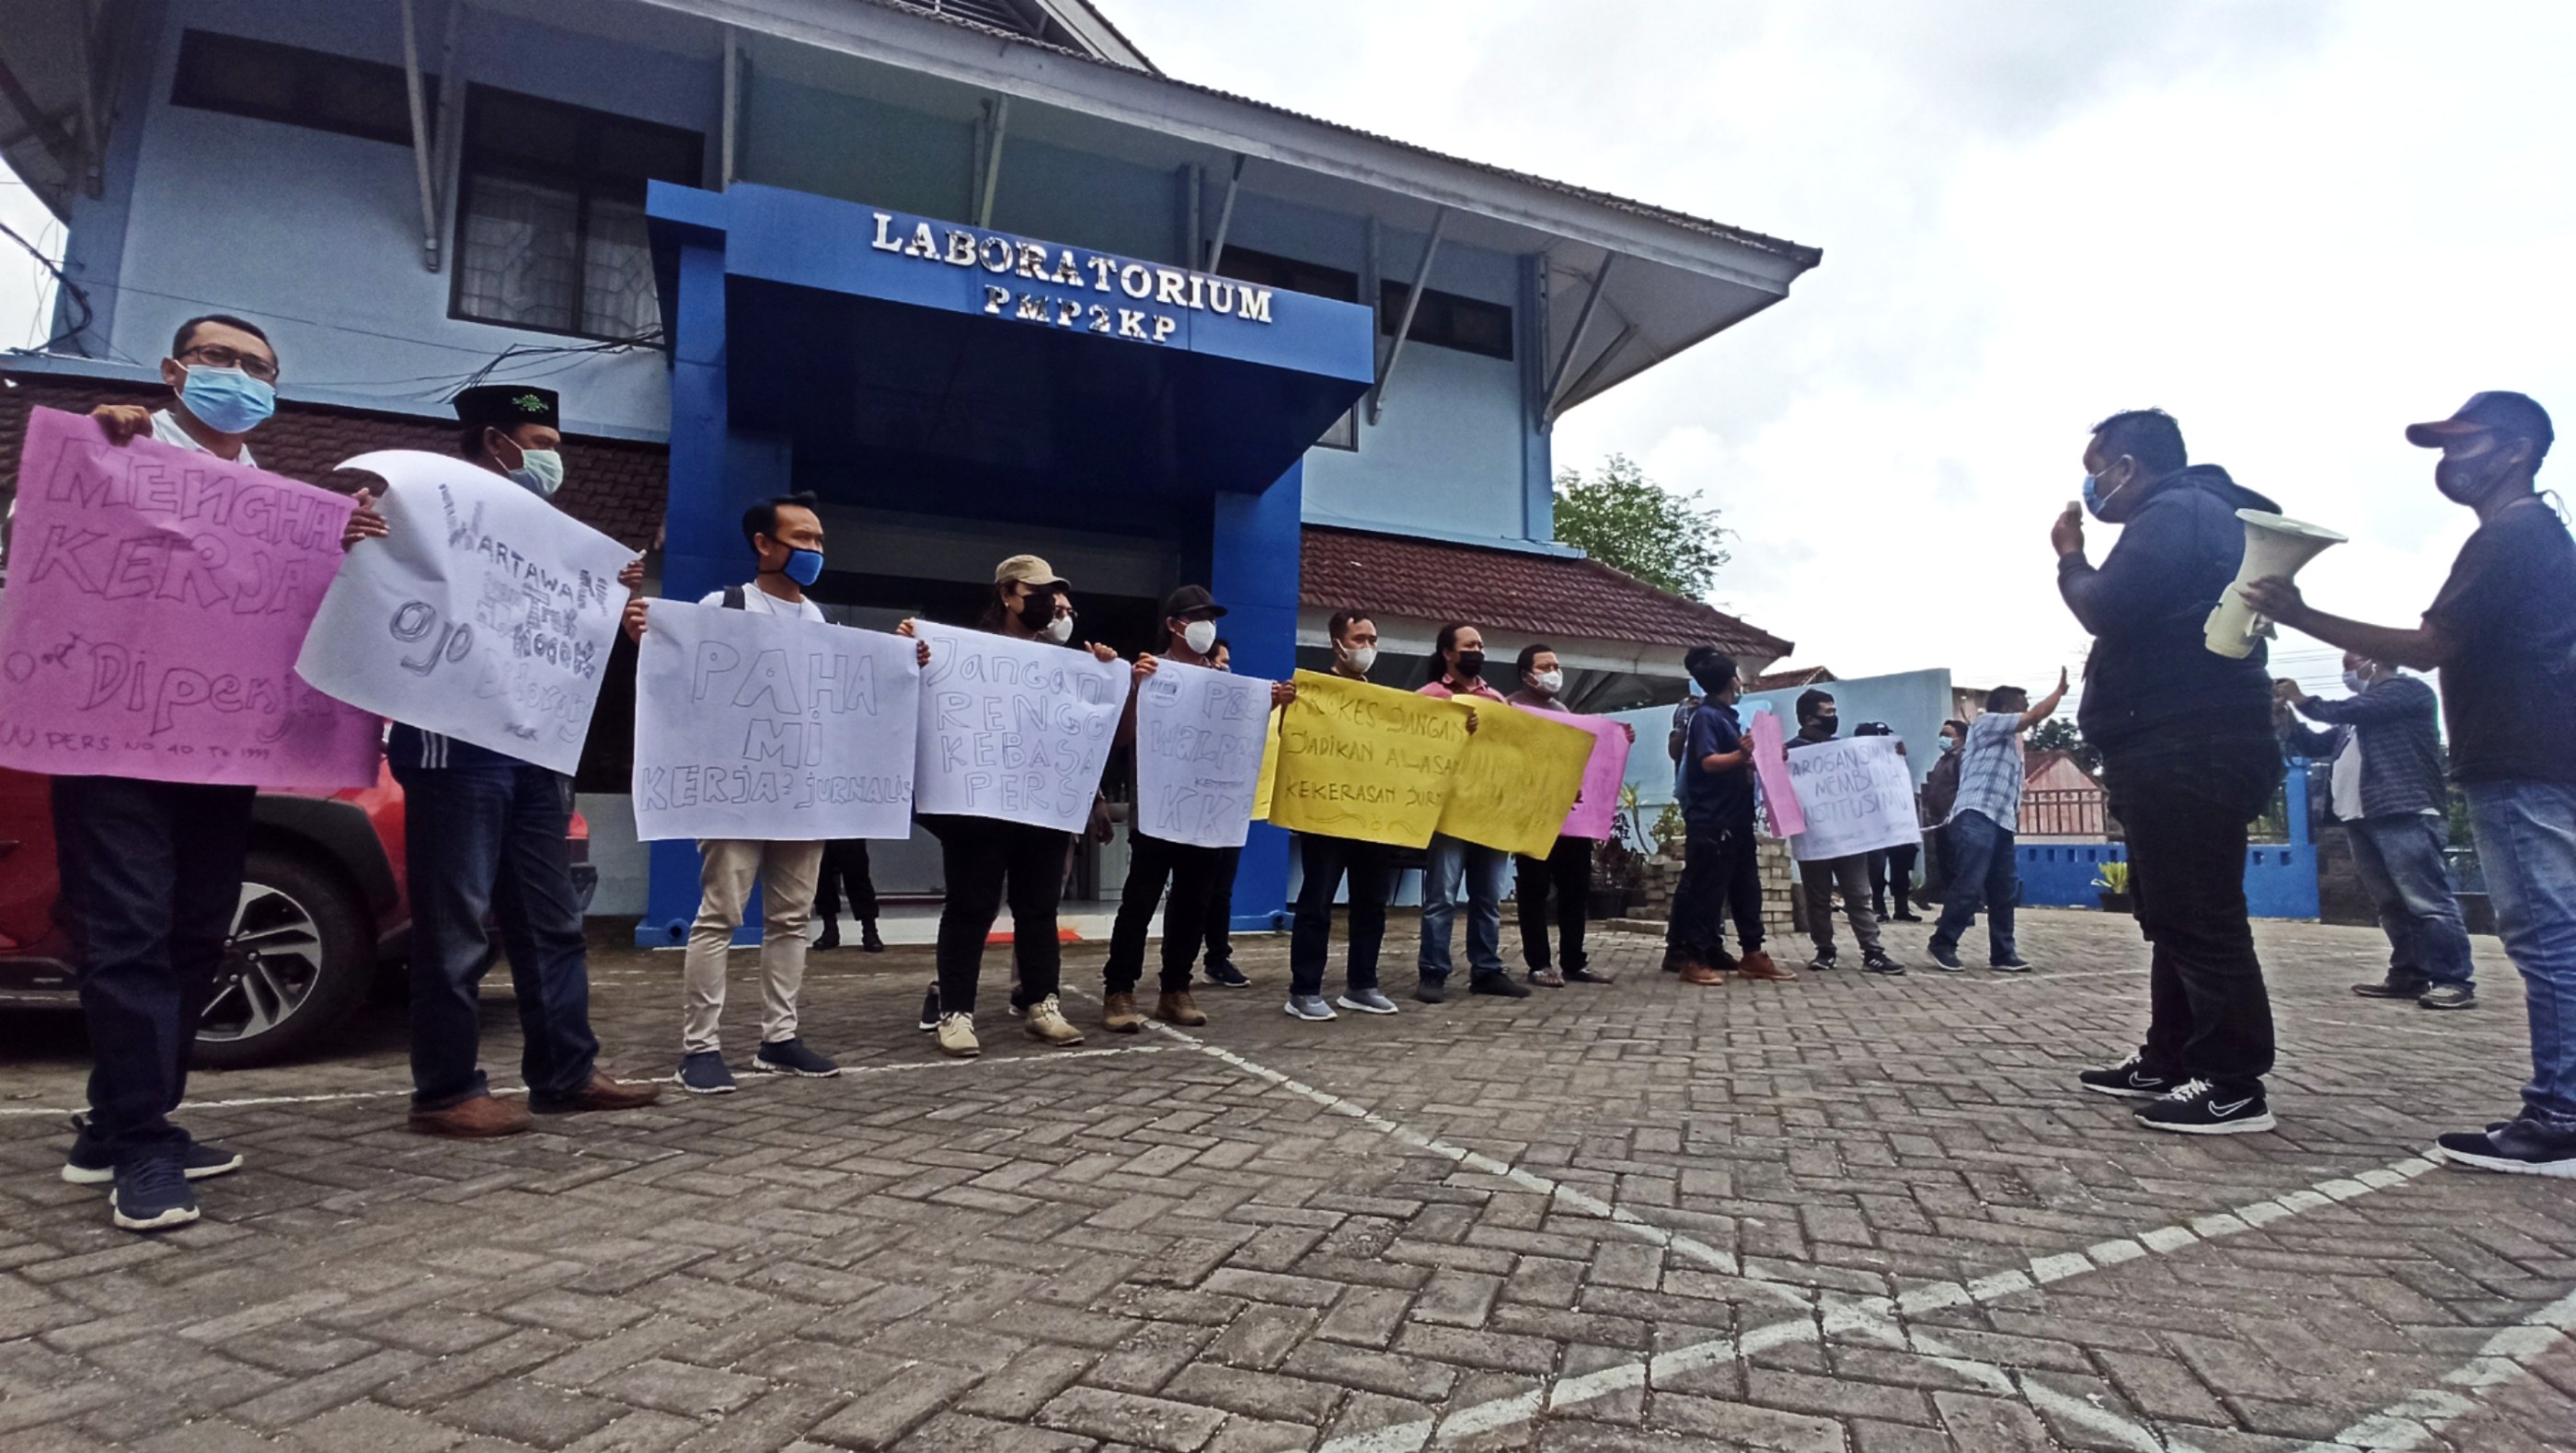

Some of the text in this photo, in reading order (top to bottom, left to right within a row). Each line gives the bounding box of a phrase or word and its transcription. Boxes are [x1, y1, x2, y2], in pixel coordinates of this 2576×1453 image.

[870, 212, 1273, 324] LABORATORIUM
[983, 283, 1177, 342] PMP2KP
[691, 640, 878, 717] PAHA
[1292, 680, 1379, 730] PROKES
[46, 731, 109, 752] PERS
[1283, 775, 1397, 803] KEKERASAN
